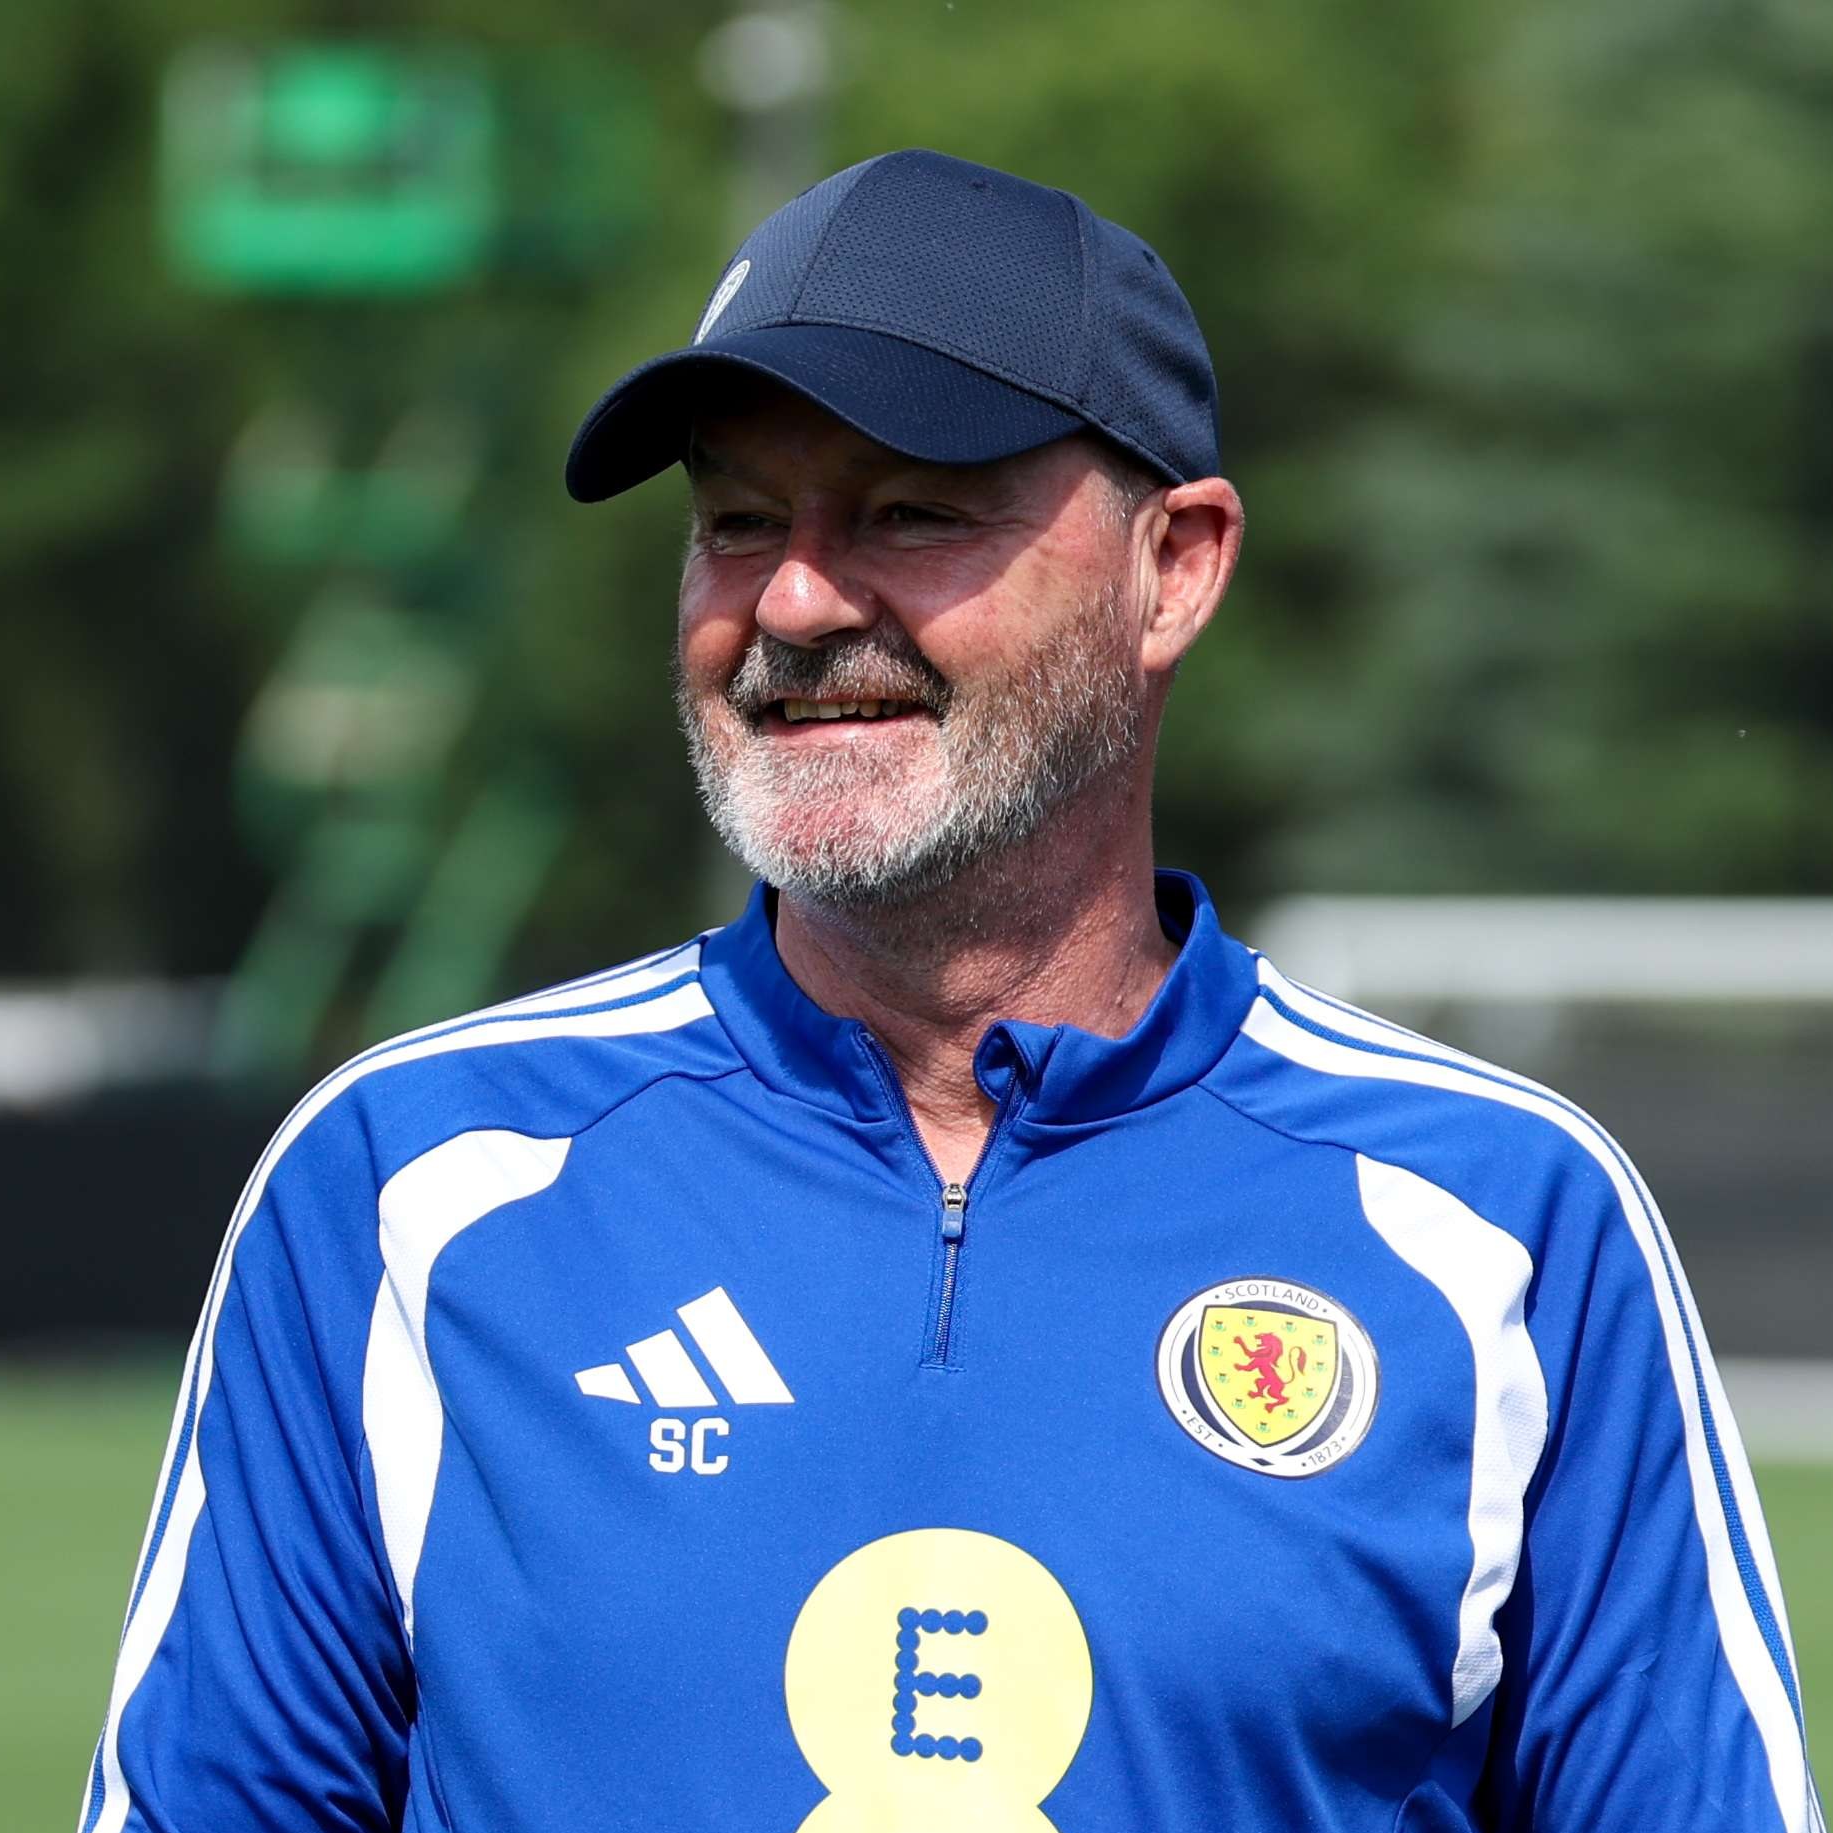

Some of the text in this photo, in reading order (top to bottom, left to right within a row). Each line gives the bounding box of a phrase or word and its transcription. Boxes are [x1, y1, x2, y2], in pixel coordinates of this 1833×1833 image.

[1224, 1284, 1319, 1310] SCOTLAND
[1186, 1417, 1214, 1441] EST
[650, 1418, 729, 1474] SC
[1308, 1440, 1342, 1467] 1873
